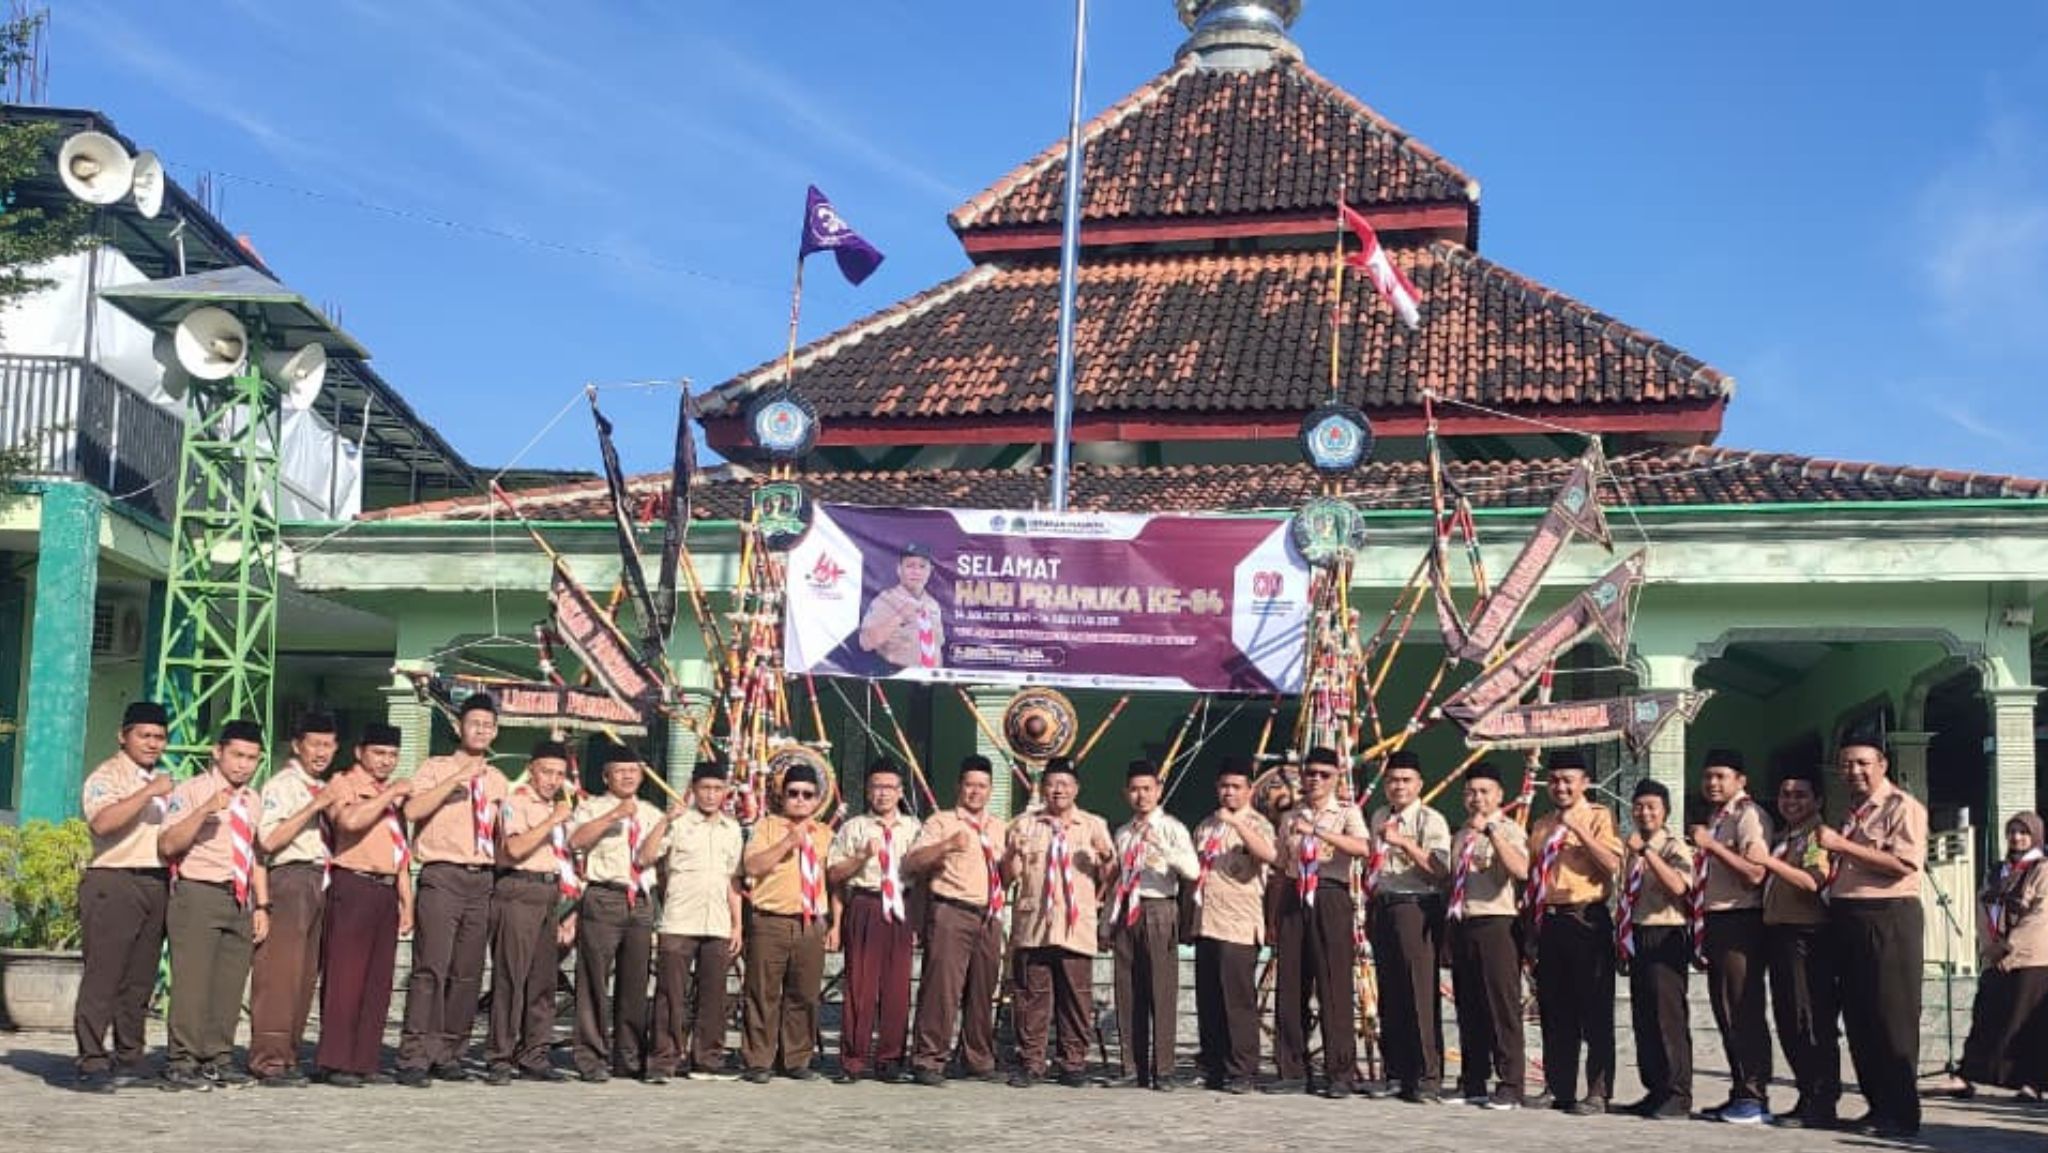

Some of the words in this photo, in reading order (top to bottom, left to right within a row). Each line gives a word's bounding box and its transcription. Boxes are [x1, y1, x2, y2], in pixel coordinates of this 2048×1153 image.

[957, 554, 1061, 580] SELAMAT
[955, 580, 1015, 608] HARI
[1020, 583, 1143, 613] PRAMUKA
